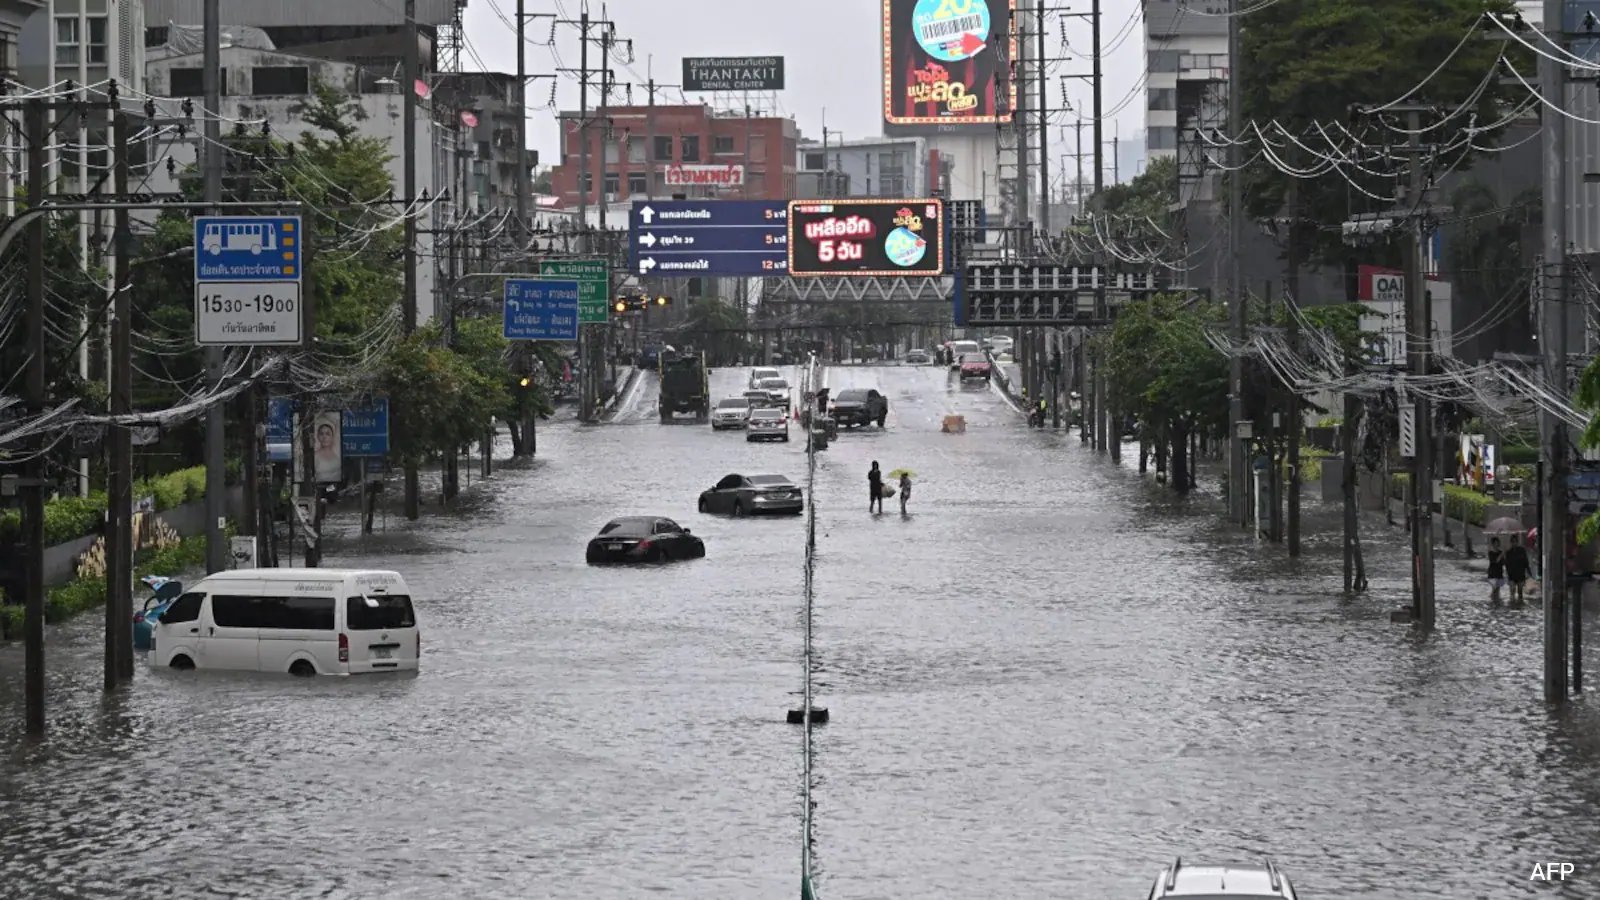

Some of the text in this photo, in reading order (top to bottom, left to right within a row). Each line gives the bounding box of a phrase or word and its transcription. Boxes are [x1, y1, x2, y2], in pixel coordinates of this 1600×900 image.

[690, 68, 776, 81] THANTAKIT
[702, 80, 765, 89] DENTAL CENTER
[764, 209, 773, 219] 5
[804, 215, 872, 239] เหลืออีก
[684, 236, 695, 244] 39
[764, 235, 773, 244] 5
[818, 240, 863, 263] 5 วัน
[761, 260, 773, 270] 12
